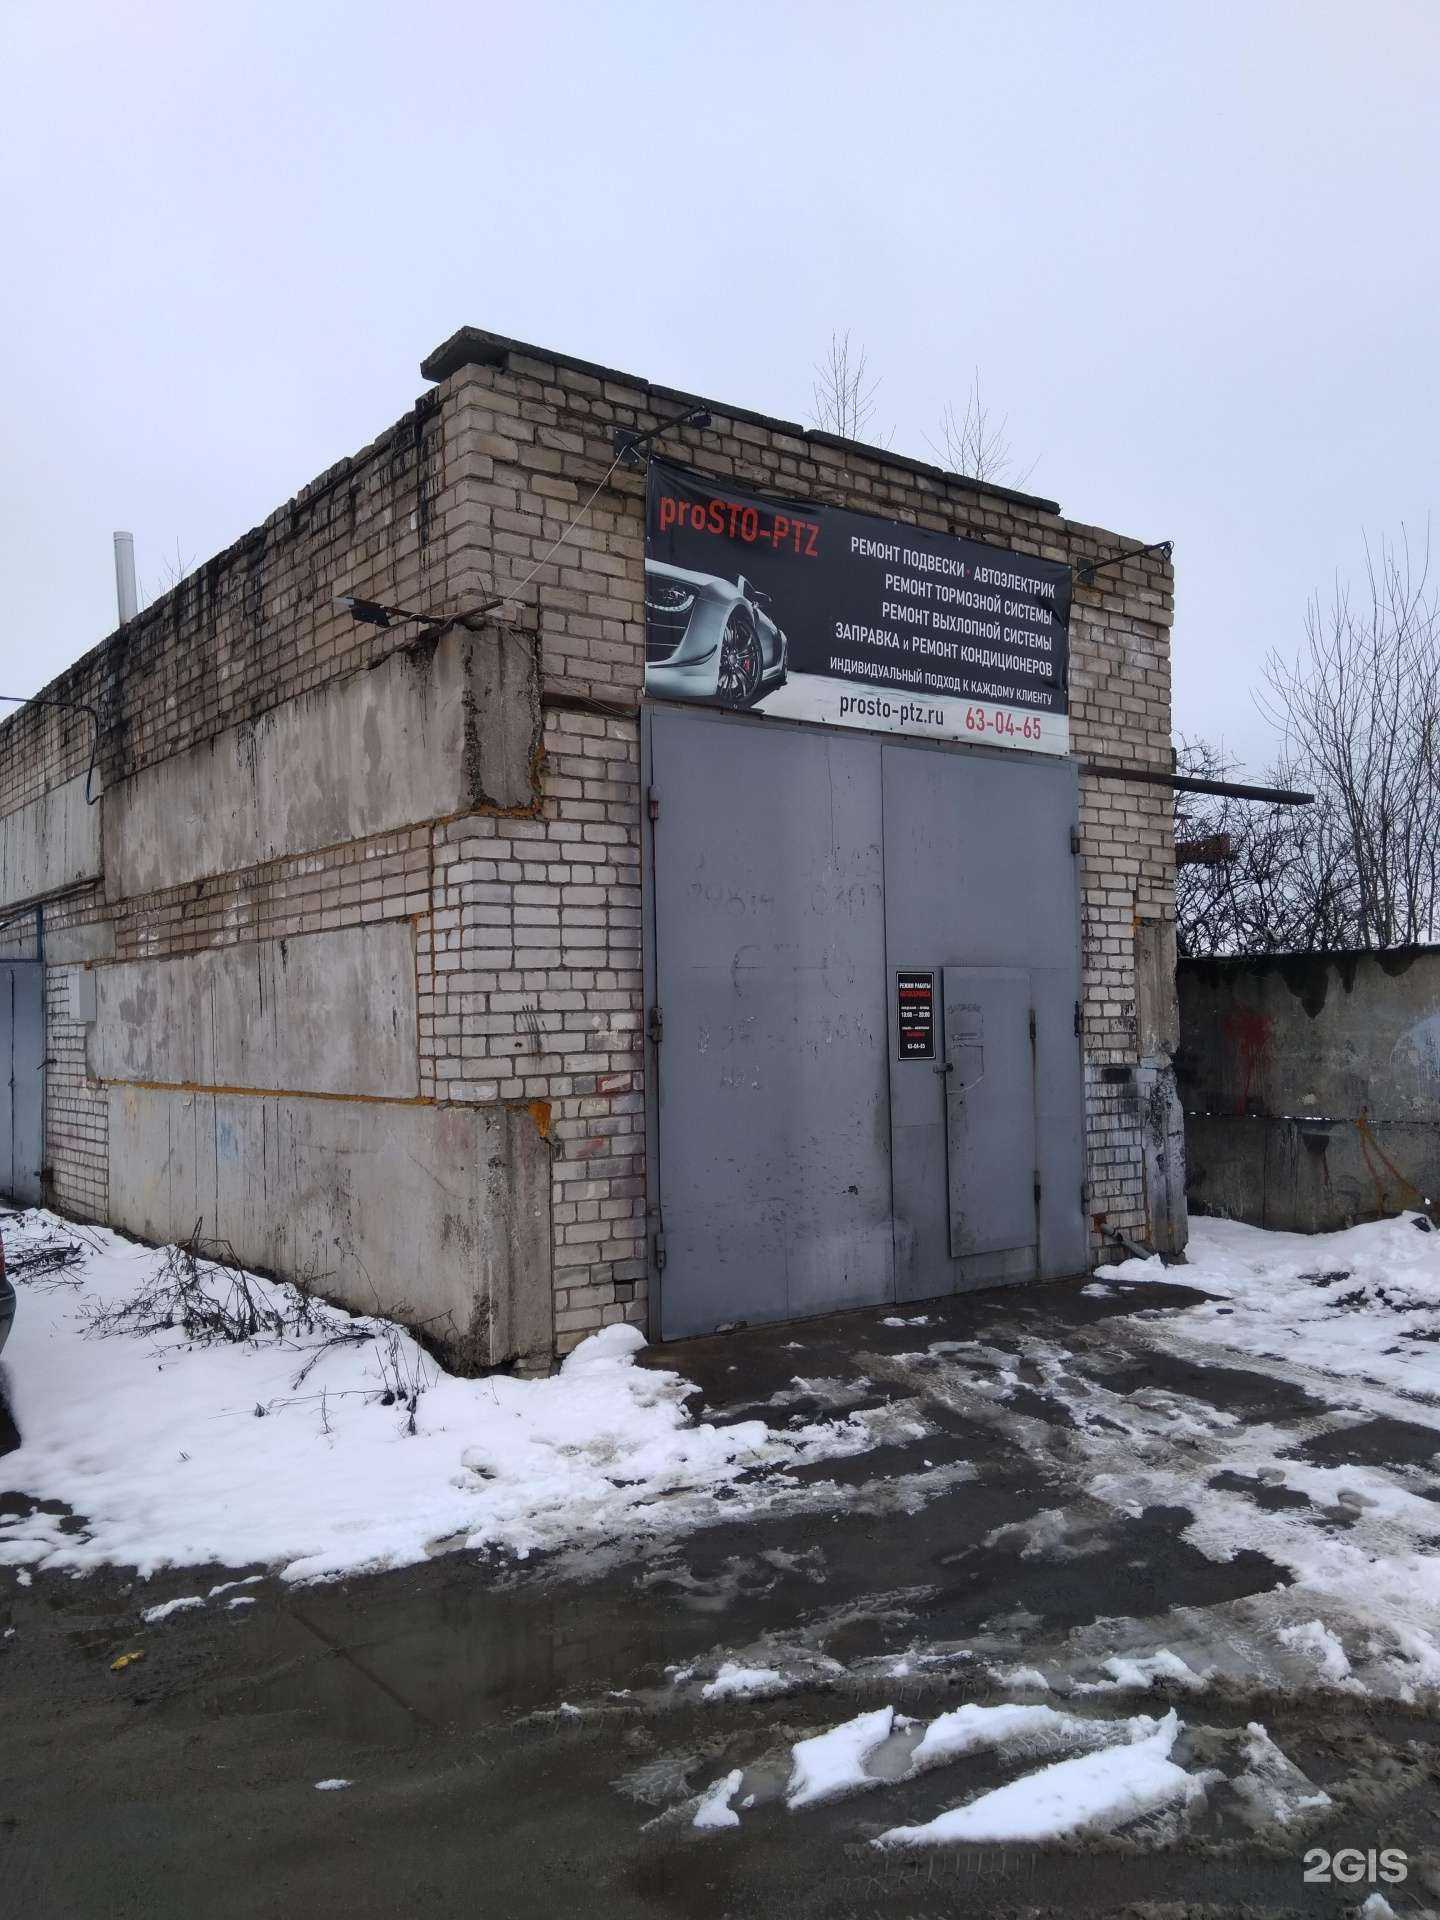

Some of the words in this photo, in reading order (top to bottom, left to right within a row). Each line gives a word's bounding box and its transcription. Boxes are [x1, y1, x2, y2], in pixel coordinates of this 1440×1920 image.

[660, 496, 819, 557] proSTO-PTZ
[851, 536, 900, 562] РЕМОНТ
[903, 549, 965, 578] ПОДВЕСКИ
[974, 566, 1055, 599] АВТОЭЛЕКТРИК
[885, 573, 933, 598] РЕМОНТ
[935, 584, 1001, 614] ТОРМОЗНОЙ
[1004, 600, 1053, 625] СИСТЕМЫ
[835, 622, 900, 649] ЗАПРАВКА
[912, 637, 958, 659] РЕМОНТ
[961, 646, 1053, 676] КОНДИЦИОНЕРОВ
[882, 602, 930, 626] РЕМОНТ
[932, 612, 1001, 640] ВЫХЛОПНОЙ
[1003, 627, 1052, 651] СИСТЕМЫ
[830, 656, 923, 684] ИНДИВИДУАЛЬНЫЙ
[925, 673, 961, 692] ПОДХОД
[963, 679, 969, 691] К
[971, 681, 1015, 698] КАЖДОМУ
[1016, 689, 1053, 705] КЛИЕНТУ
[840, 695, 944, 726] prosto-ptz.ru
[965, 706, 1041, 740] 63-04-65
